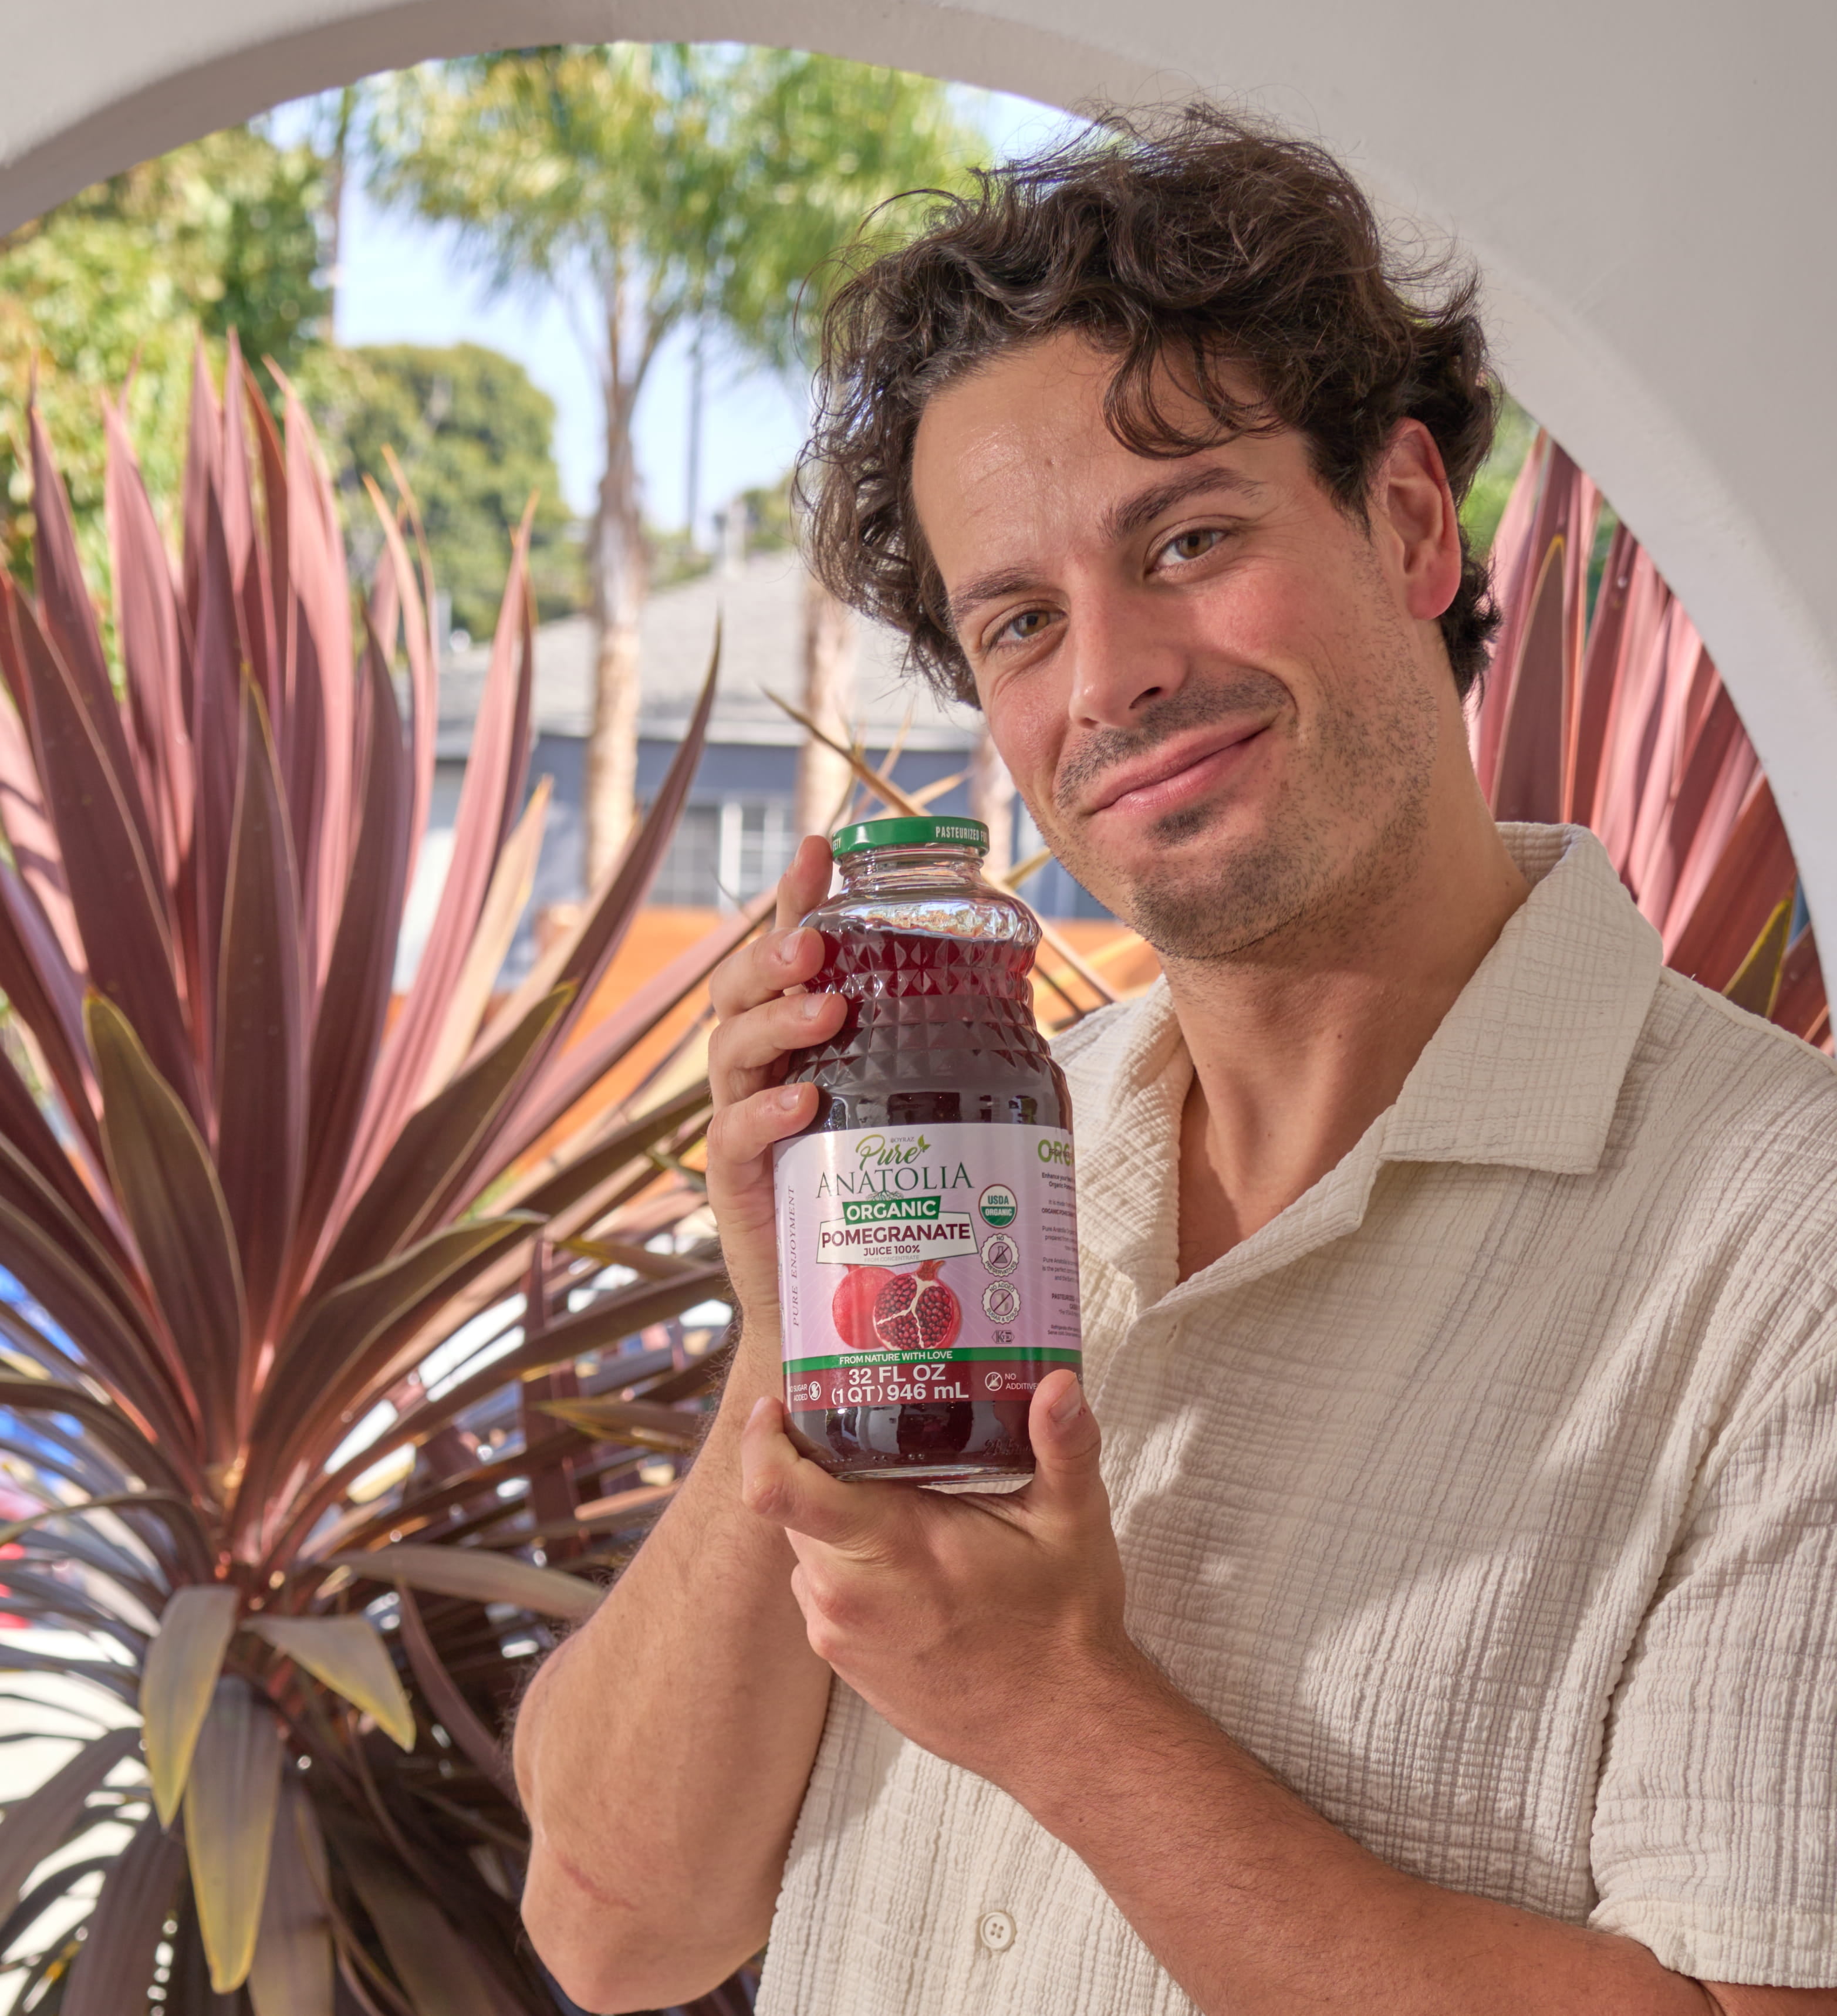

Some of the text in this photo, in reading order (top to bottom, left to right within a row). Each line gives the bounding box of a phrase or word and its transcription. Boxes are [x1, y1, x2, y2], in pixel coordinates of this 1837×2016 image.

[936, 826, 980, 840] PASTEURIZED
[855, 1134, 920, 1171] Pure
[815, 1161, 975, 1198] ANATOLIA
[988, 1195, 1009, 1205] USDA
[846, 1200, 936, 1221] ORGANIC
[985, 1208, 1012, 1217] ORGANIC
[788, 1186, 798, 1279] ENJOYMENT
[822, 1223, 971, 1248] POMEGRANATE
[863, 1245, 920, 1257] JUICE 100%
[985, 1261, 1017, 1275] PRESERVATIVES
[998, 1283, 1014, 1292] ADDED
[987, 1308, 1001, 1321] SUGAR
[1006, 1308, 1017, 1321] SYRUP
[839, 1350, 953, 1365] FROM NATURE WITH LOVE
[849, 1363, 945, 1385] 32 FL OZ
[793, 1384, 807, 1392] SUGAR
[887, 1383, 926, 1402] 946
[934, 1382, 968, 1399] mL
[793, 1393, 808, 1402] ADDED
